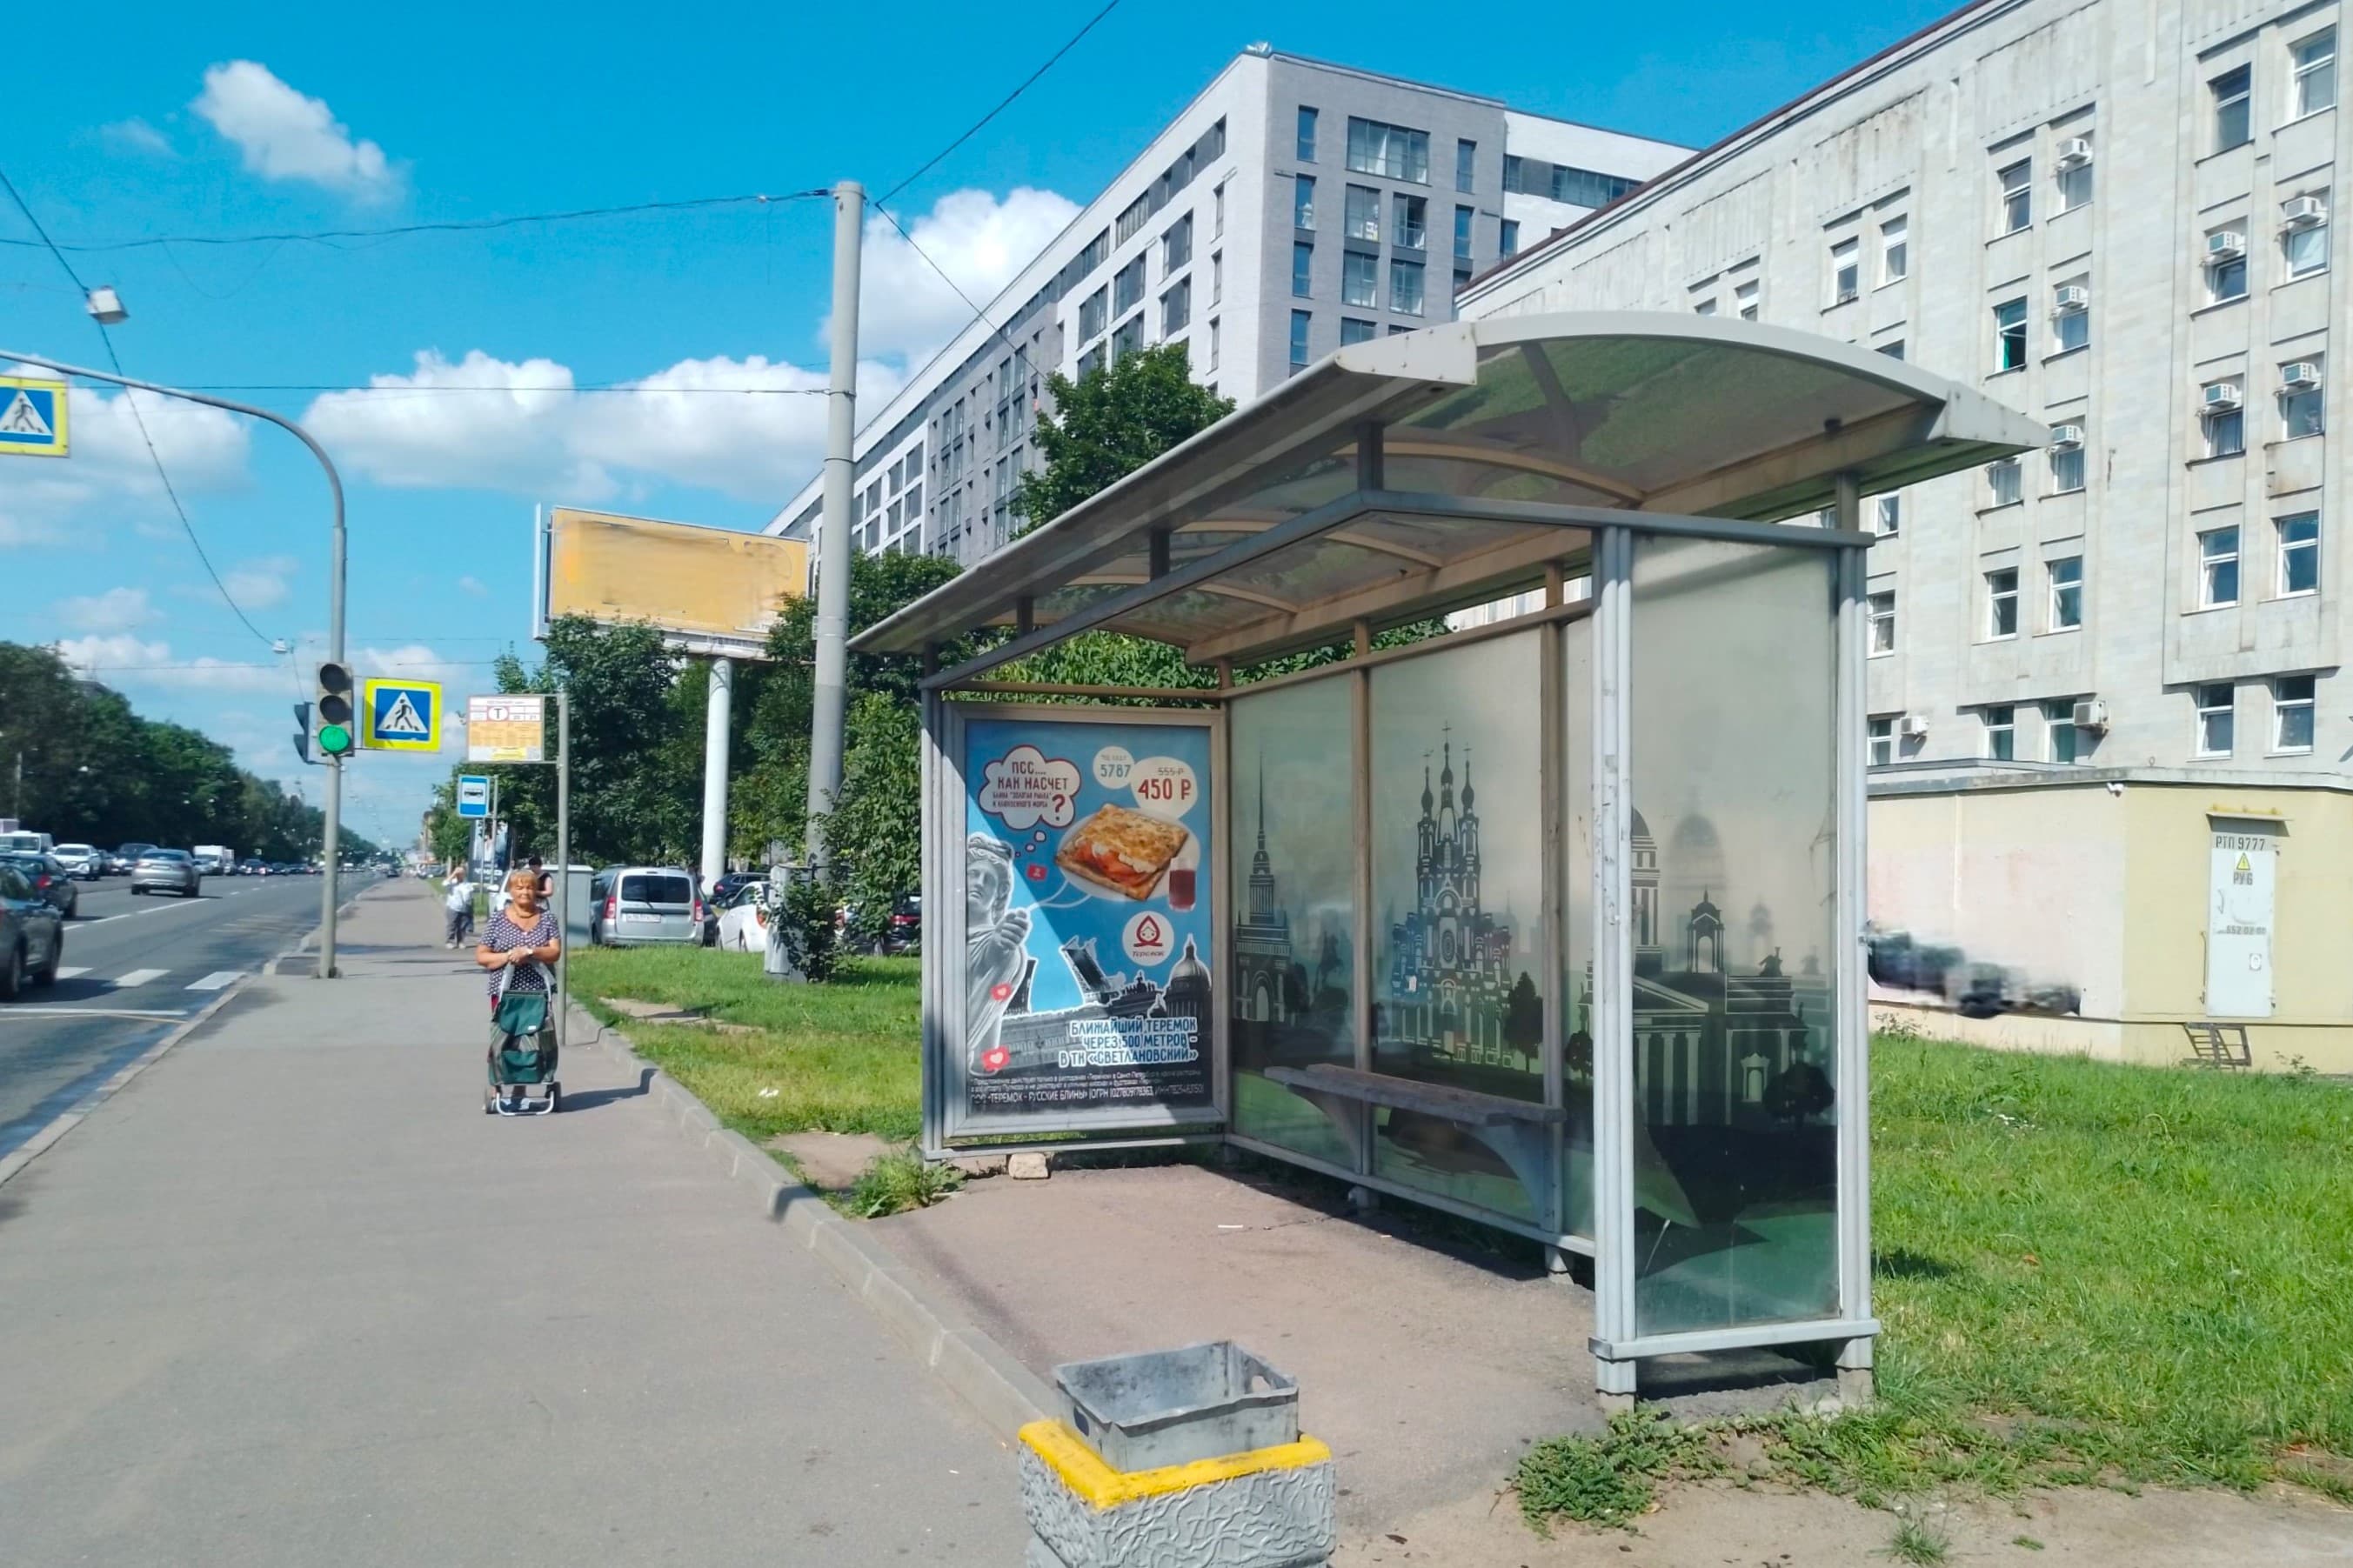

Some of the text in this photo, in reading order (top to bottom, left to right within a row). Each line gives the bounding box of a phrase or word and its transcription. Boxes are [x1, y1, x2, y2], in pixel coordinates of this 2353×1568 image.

[1100, 764, 1131, 777] 5787
[998, 777, 1069, 791] КАК НАСЧЕТ
[1138, 778, 1173, 800] 450
[2216, 836, 2266, 851] РТП 9777
[1071, 1018, 1197, 1036] БЛИЖАЙШИЙ ТЕРЕМОК
[1083, 1036, 1118, 1050] ЧЕРЕЗ
[1122, 1035, 1140, 1048] 500
[1143, 1033, 1187, 1047] МЕТРОВ
[1060, 1048, 1199, 1065] В ТК «СВЕТЛАНОВСКИЙ»
